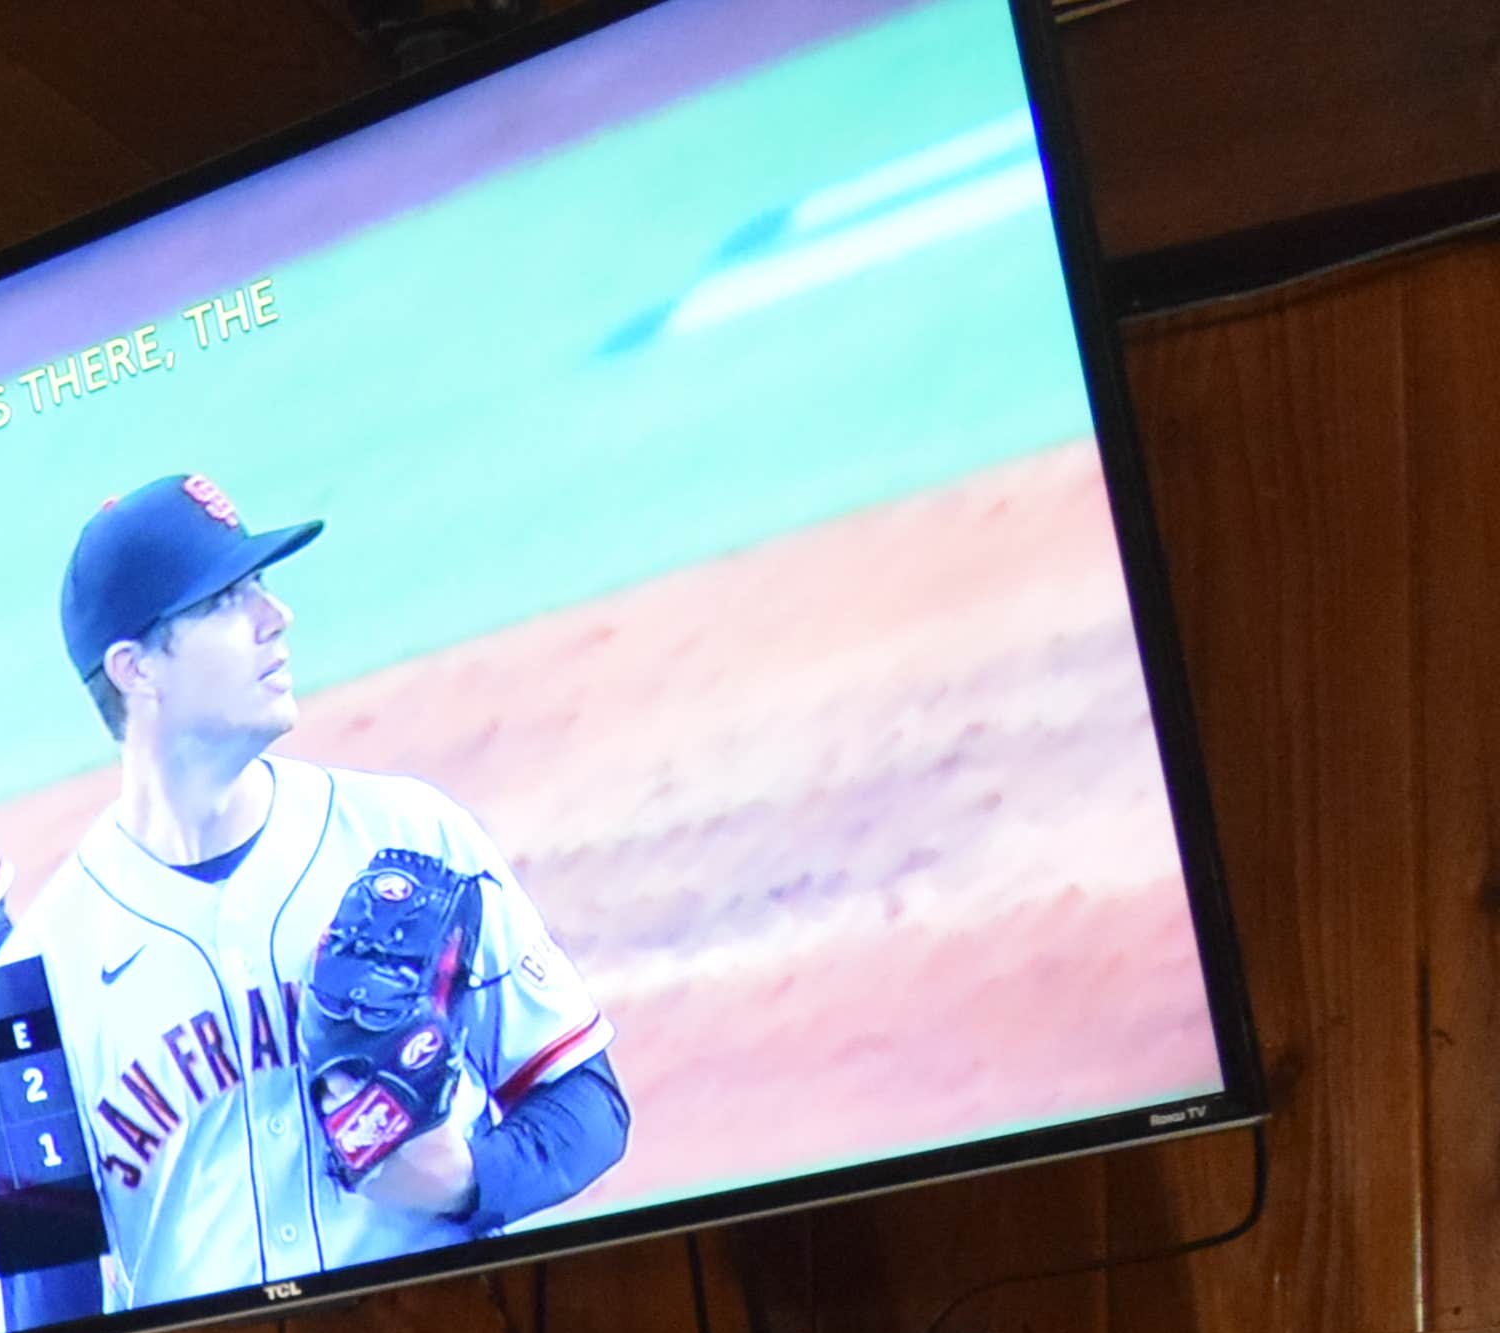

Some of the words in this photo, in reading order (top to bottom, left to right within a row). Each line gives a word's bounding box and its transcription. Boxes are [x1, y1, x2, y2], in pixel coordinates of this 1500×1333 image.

[18, 325, 177, 413] THERE,
[182, 279, 281, 351] THE
[12, 1021, 32, 1051] E
[22, 1066, 49, 1103] 2
[97, 1058, 182, 1190] SAN
[1188, 1105, 1208, 1120] TV
[38, 1134, 62, 1169] 1
[263, 1282, 302, 1301] TCL
